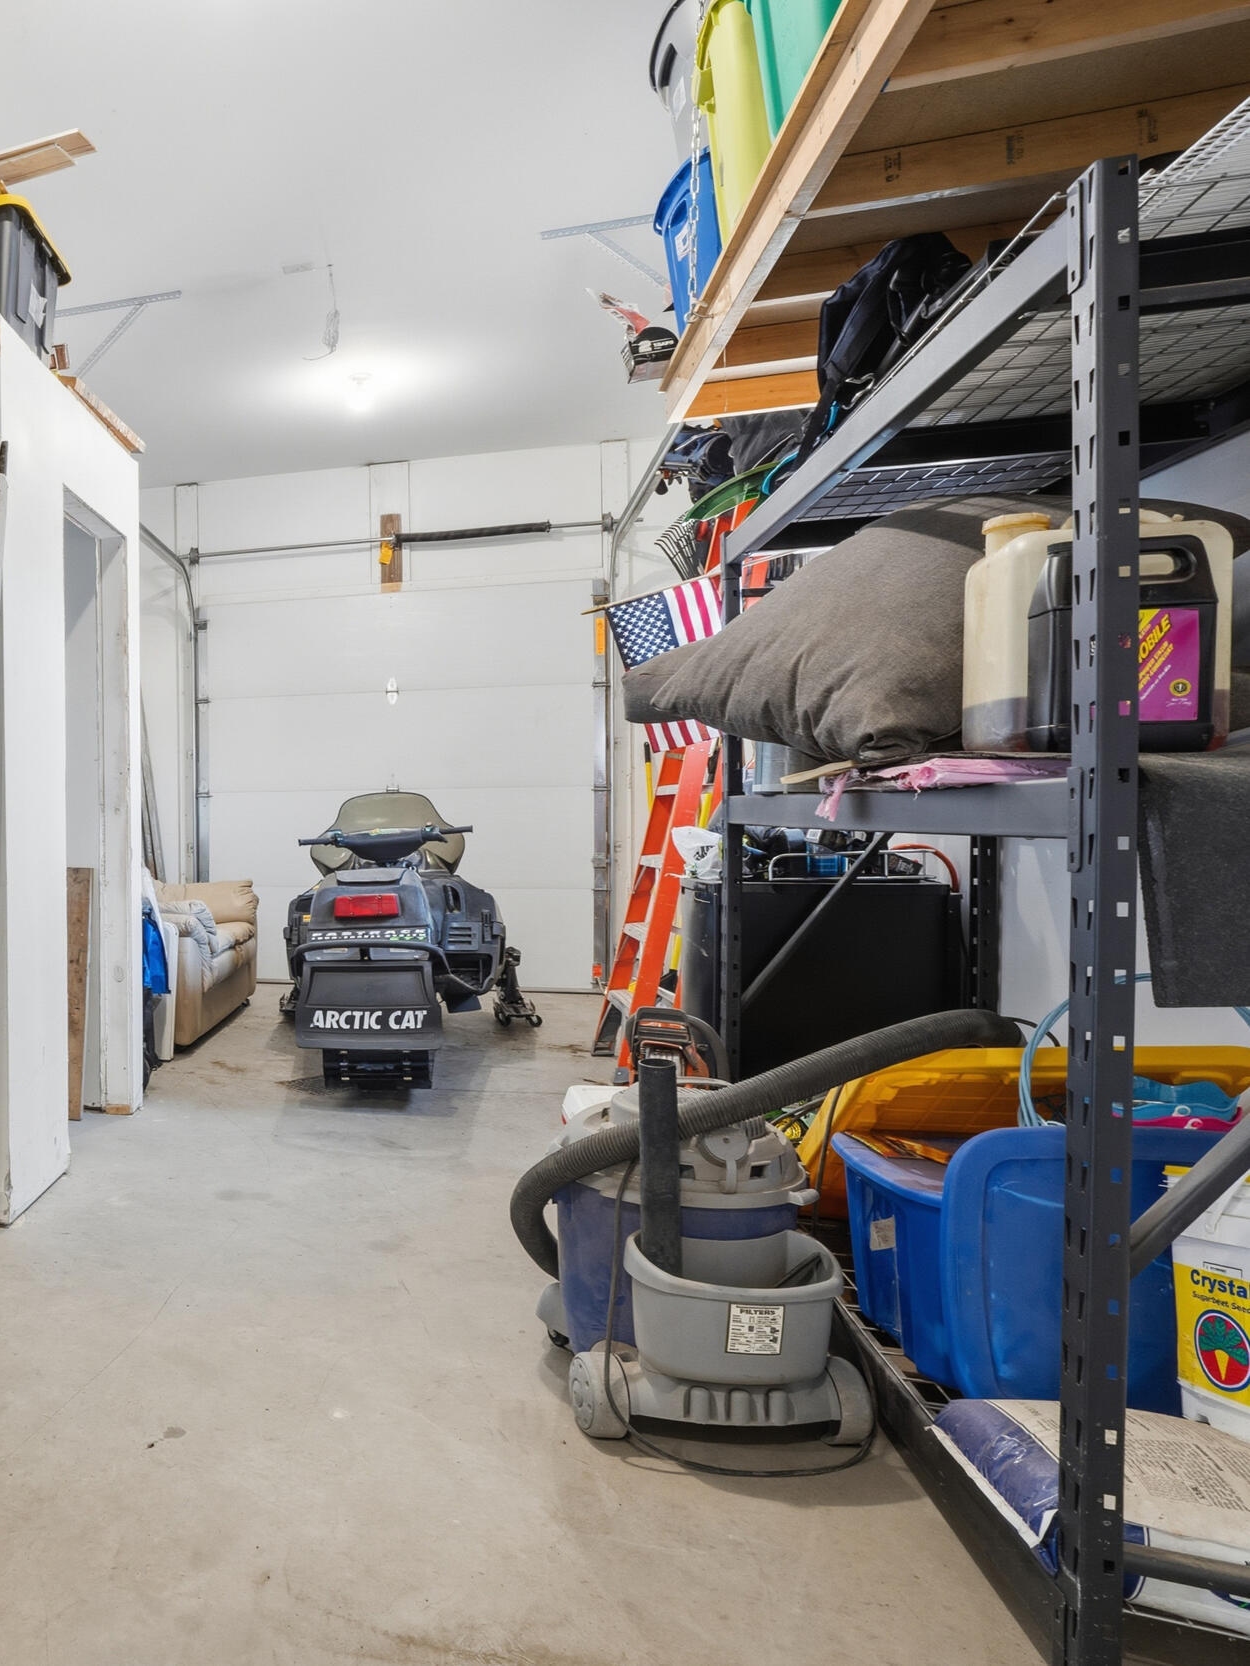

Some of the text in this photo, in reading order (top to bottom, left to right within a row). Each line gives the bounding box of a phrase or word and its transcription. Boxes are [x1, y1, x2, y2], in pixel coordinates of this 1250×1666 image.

[310, 1010, 427, 1030] ARCTIC CAT
[1191, 1269, 1250, 1299] Crysta
